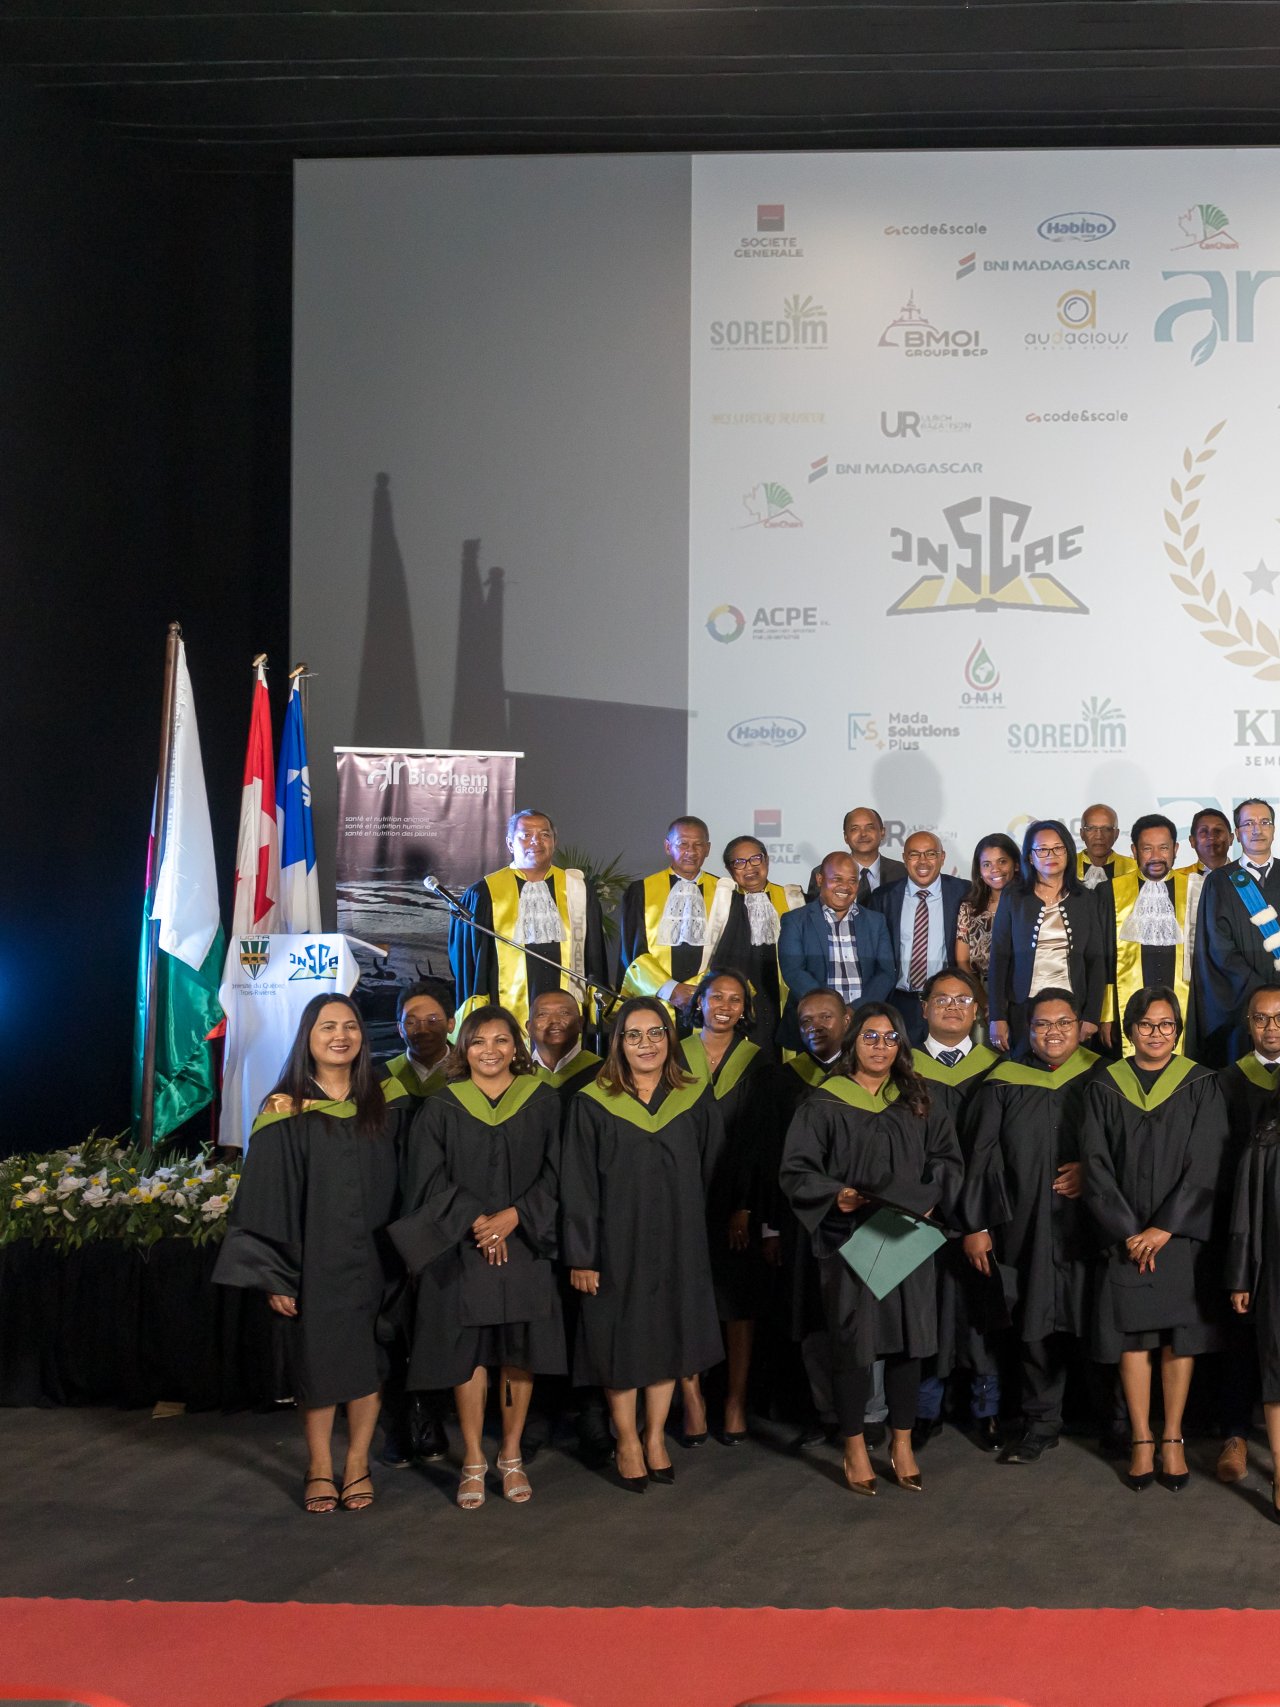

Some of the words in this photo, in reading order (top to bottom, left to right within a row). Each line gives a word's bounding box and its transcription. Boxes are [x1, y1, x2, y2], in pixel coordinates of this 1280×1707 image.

[902, 223, 988, 236] code&scale
[1046, 219, 1106, 236] Habibo
[740, 237, 797, 247] SOCIETE
[734, 248, 804, 258] GENERALE
[983, 260, 1010, 272] BNI
[1013, 259, 1131, 272] MADAGASCAR
[904, 330, 980, 348] BMOI
[905, 349, 960, 357] GROUPE
[963, 349, 989, 357] BCP
[1043, 410, 1129, 423] code&scale
[881, 411, 921, 438] UR
[835, 463, 862, 475] BNI
[864, 462, 983, 475] MADAGASCAR
[752, 607, 817, 627] ACPE
[889, 712, 929, 724] Mada
[736, 725, 798, 740] Habibo
[888, 725, 961, 738] Solutions
[888, 738, 920, 750] Plus
[409, 769, 488, 787] Biochem
[455, 786, 488, 794] GROUP
